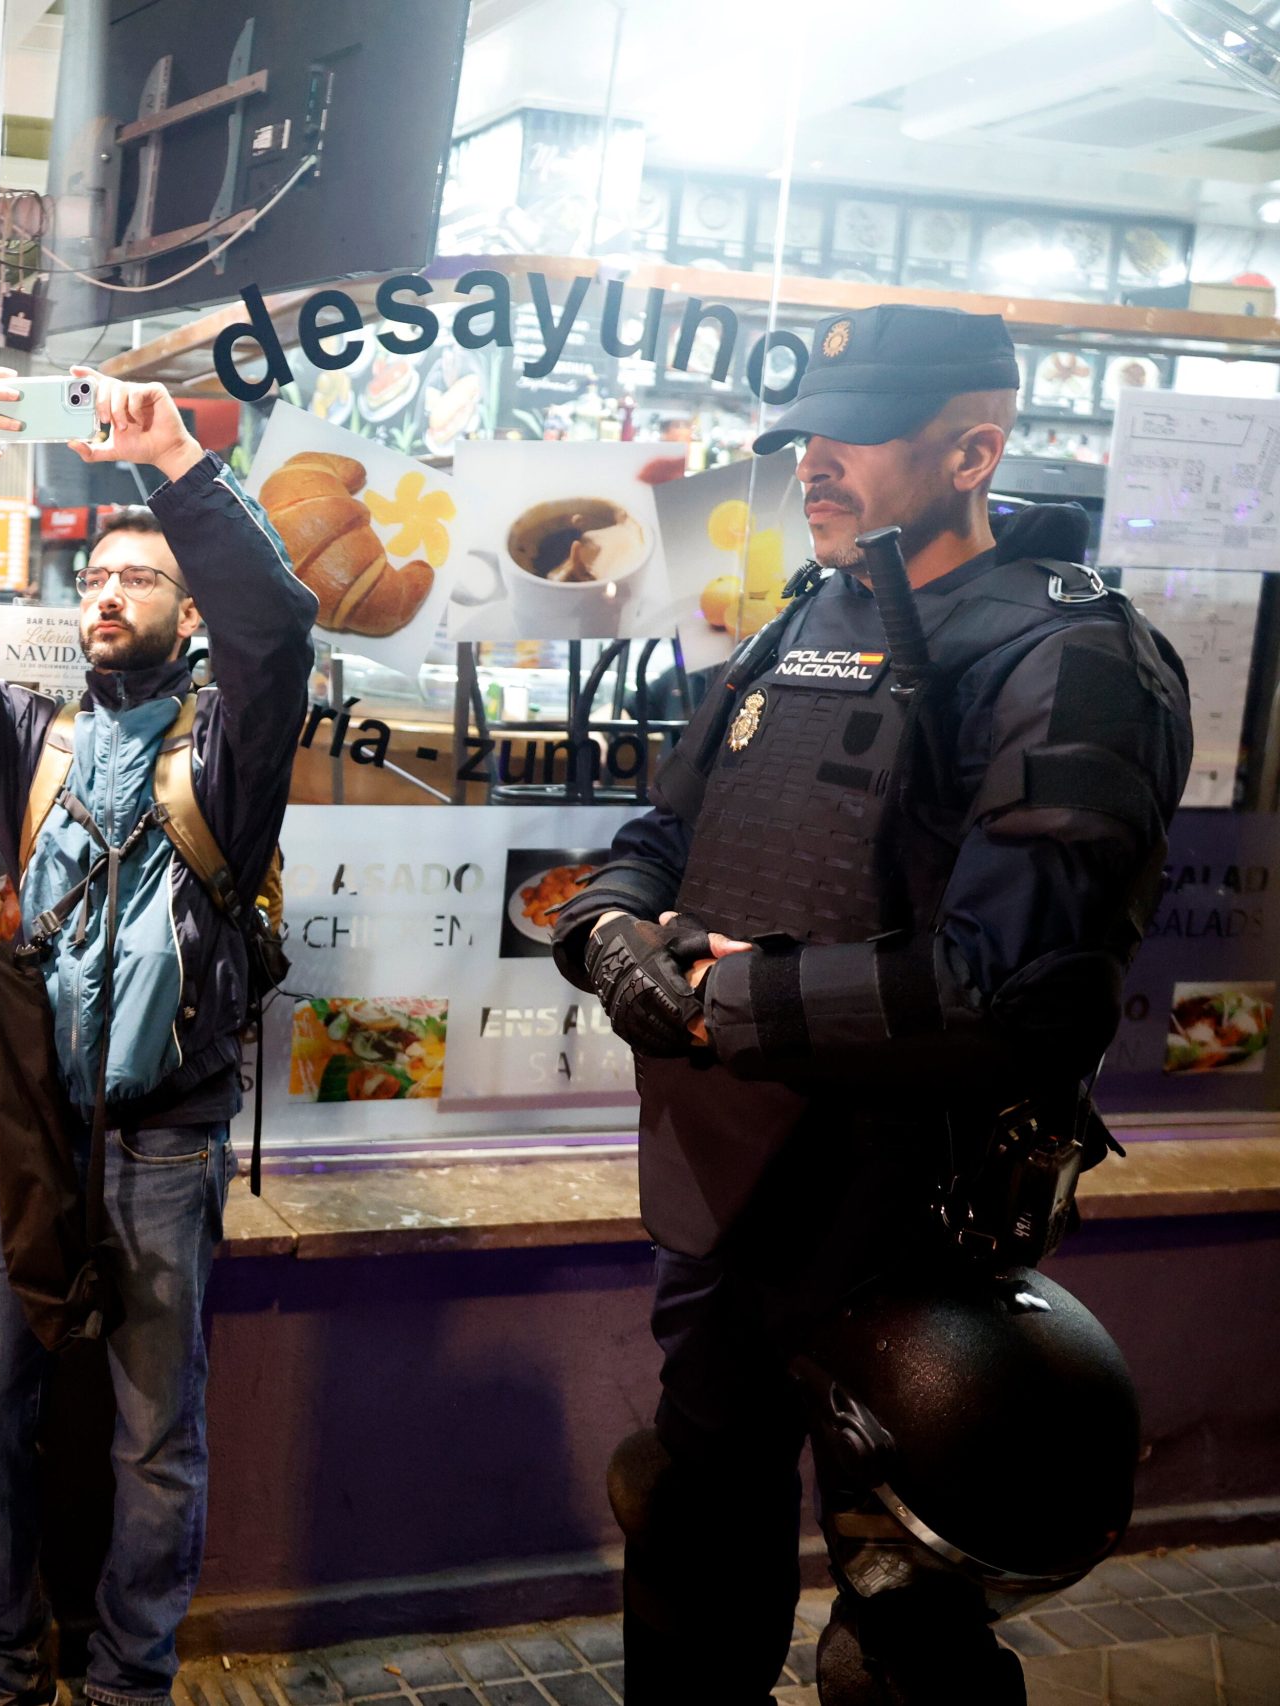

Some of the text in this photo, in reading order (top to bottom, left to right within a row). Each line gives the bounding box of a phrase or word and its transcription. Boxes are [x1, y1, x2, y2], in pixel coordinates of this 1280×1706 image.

[212, 269, 809, 405] desayuno
[26, 617, 43, 625] BAR
[46, 618, 56, 626] EL
[774, 662, 873, 680] NACIONAL
[332, 862, 485, 896] ASADO
